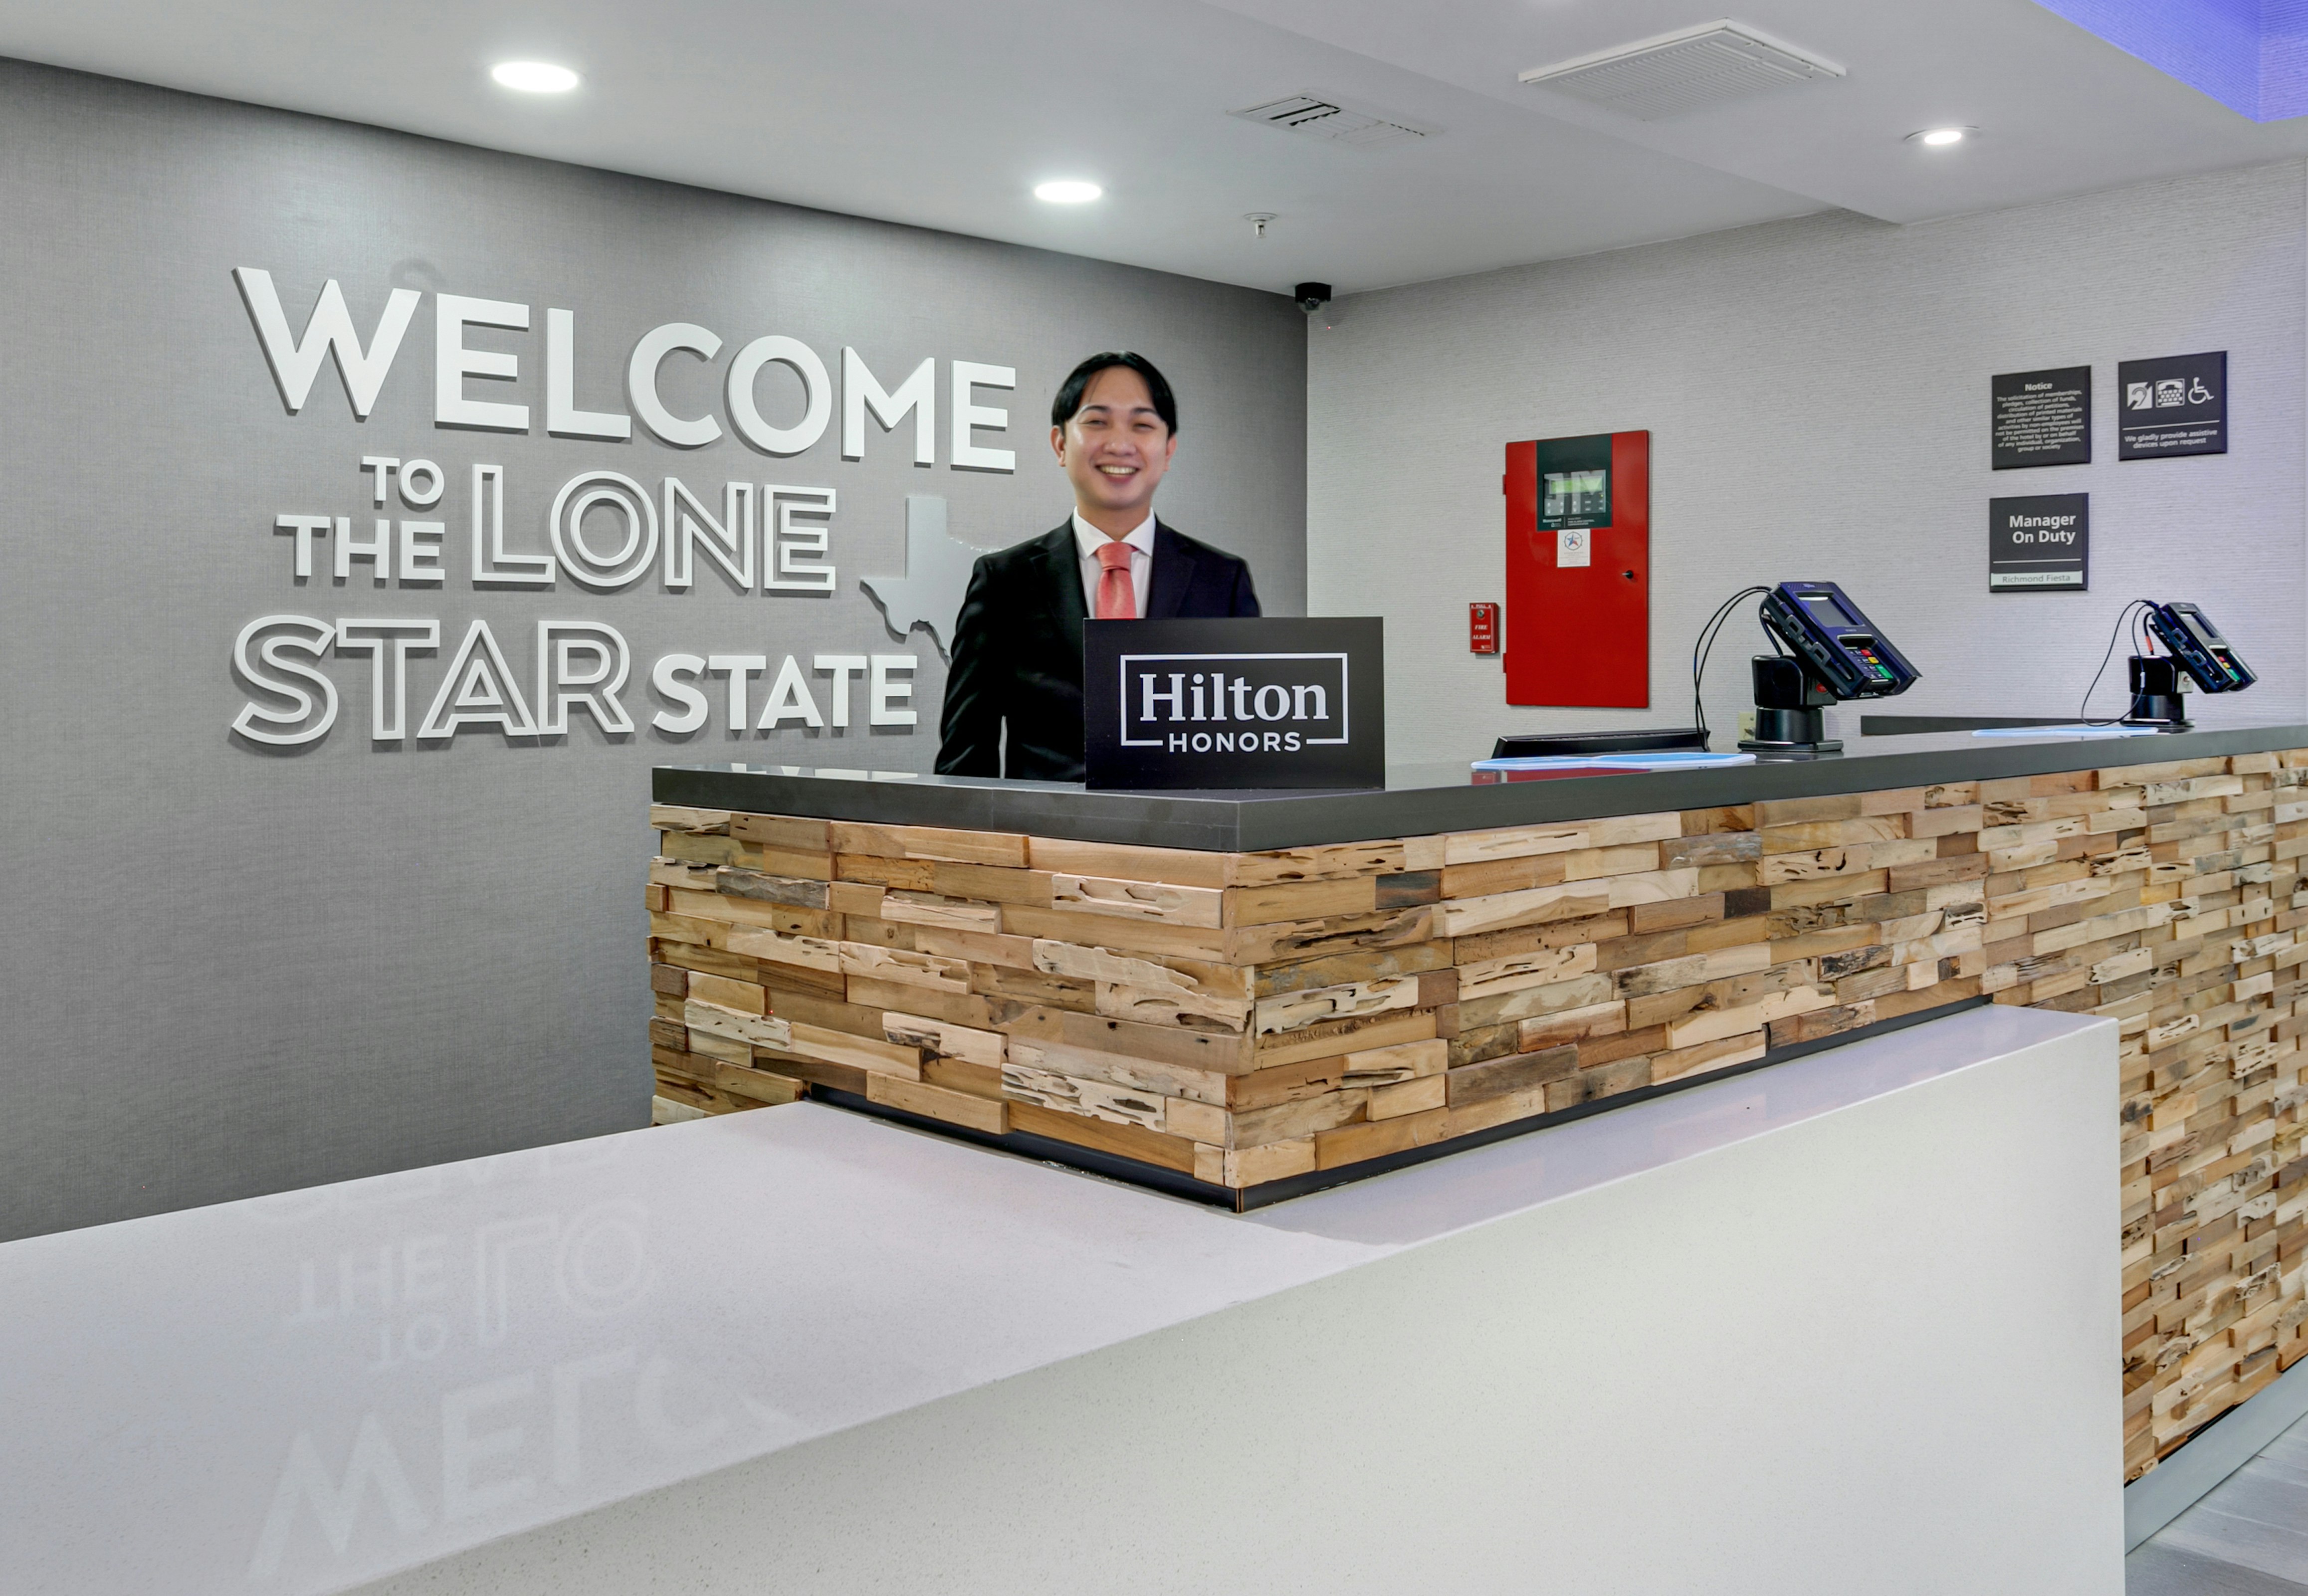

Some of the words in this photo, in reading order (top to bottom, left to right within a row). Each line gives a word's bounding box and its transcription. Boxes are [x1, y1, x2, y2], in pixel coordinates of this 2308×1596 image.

[232, 264, 1016, 471] WELCOME
[2025, 382, 2053, 391] Notice
[2137, 433, 2159, 442] gladly
[2160, 431, 2187, 440] provide
[362, 455, 445, 506] TO
[472, 463, 836, 592] LONE
[2010, 515, 2076, 529] Manager
[2012, 531, 2034, 544] On
[2039, 530, 2076, 545] Duty
[276, 514, 446, 581] THE
[231, 614, 634, 746] STAR
[651, 653, 918, 734] STATE
[1139, 673, 1329, 722] Hilton
[1169, 731, 1301, 753] HONORS
